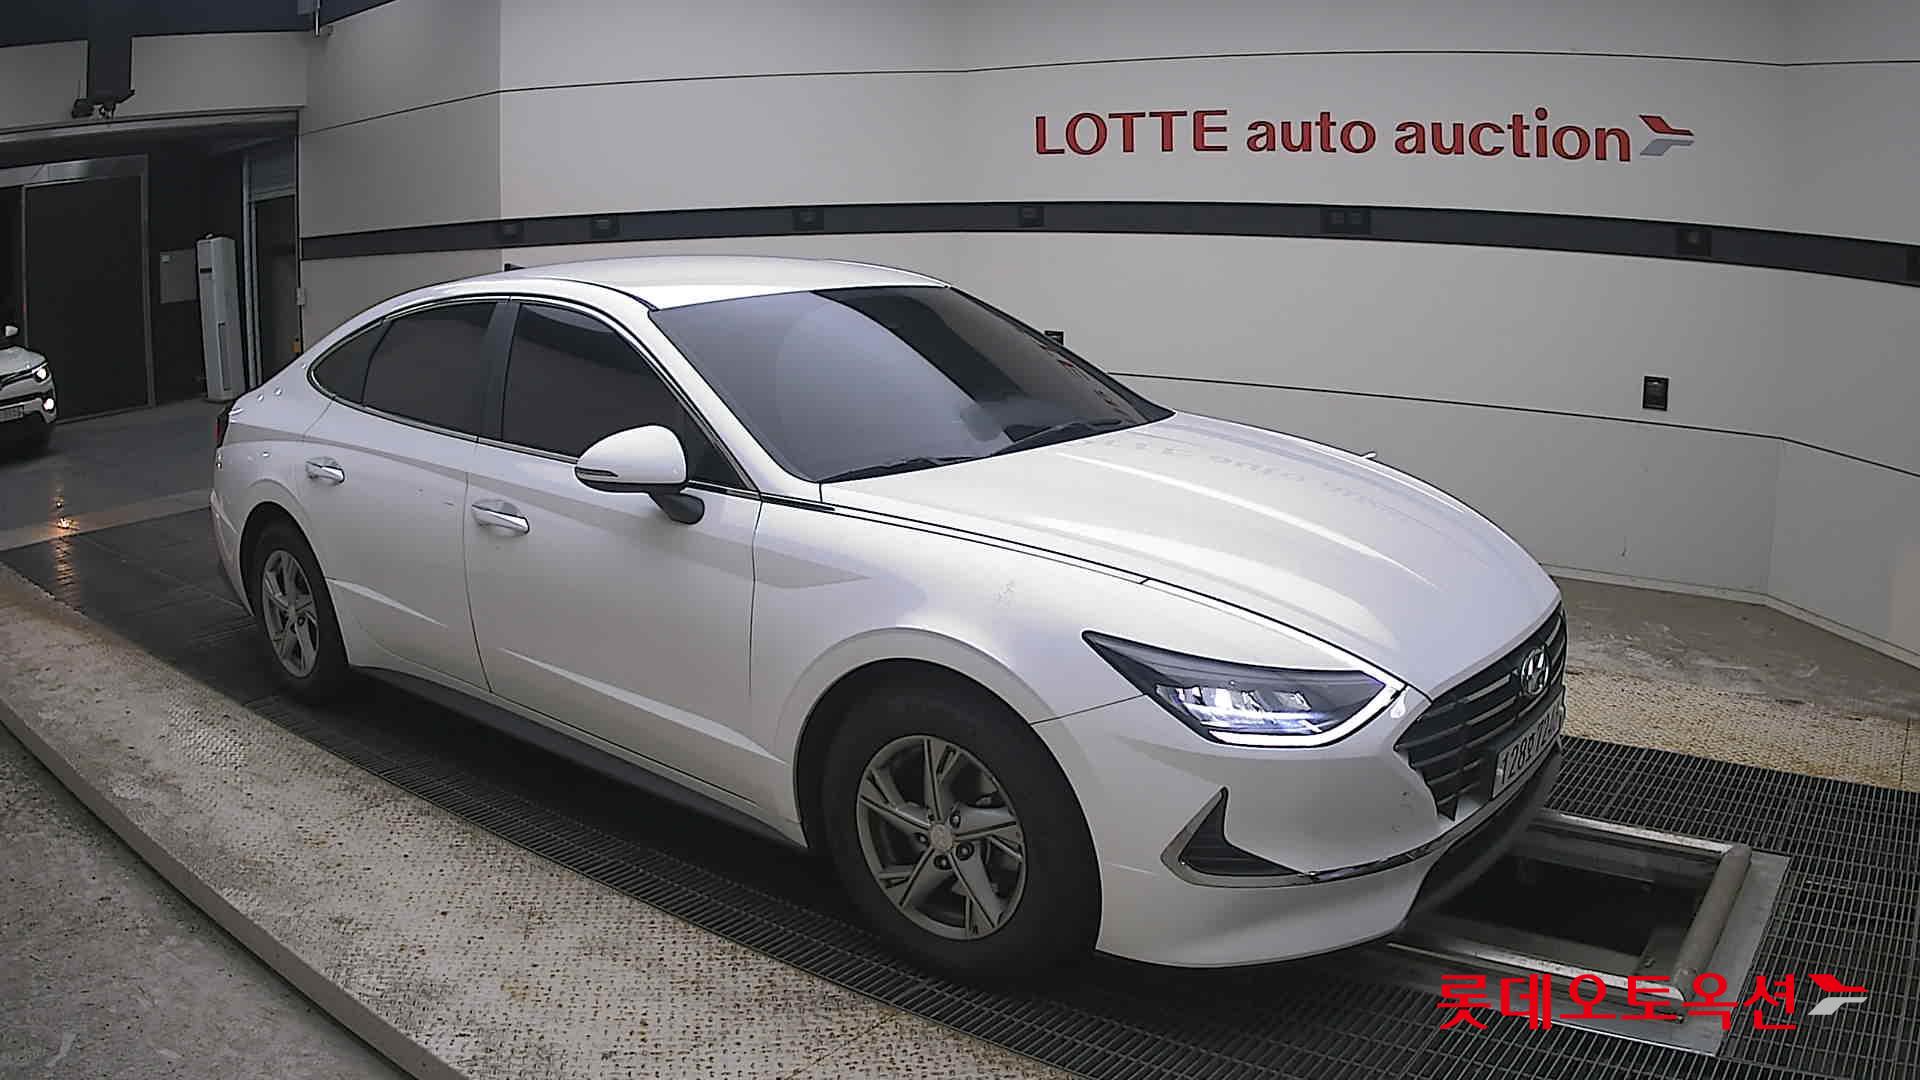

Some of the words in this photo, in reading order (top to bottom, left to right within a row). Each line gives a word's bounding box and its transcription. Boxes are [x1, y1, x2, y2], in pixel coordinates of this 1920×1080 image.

[1035, 110, 1228, 156] LOTTE
[1246, 111, 1377, 155] auto
[1394, 107, 1632, 163] auction
